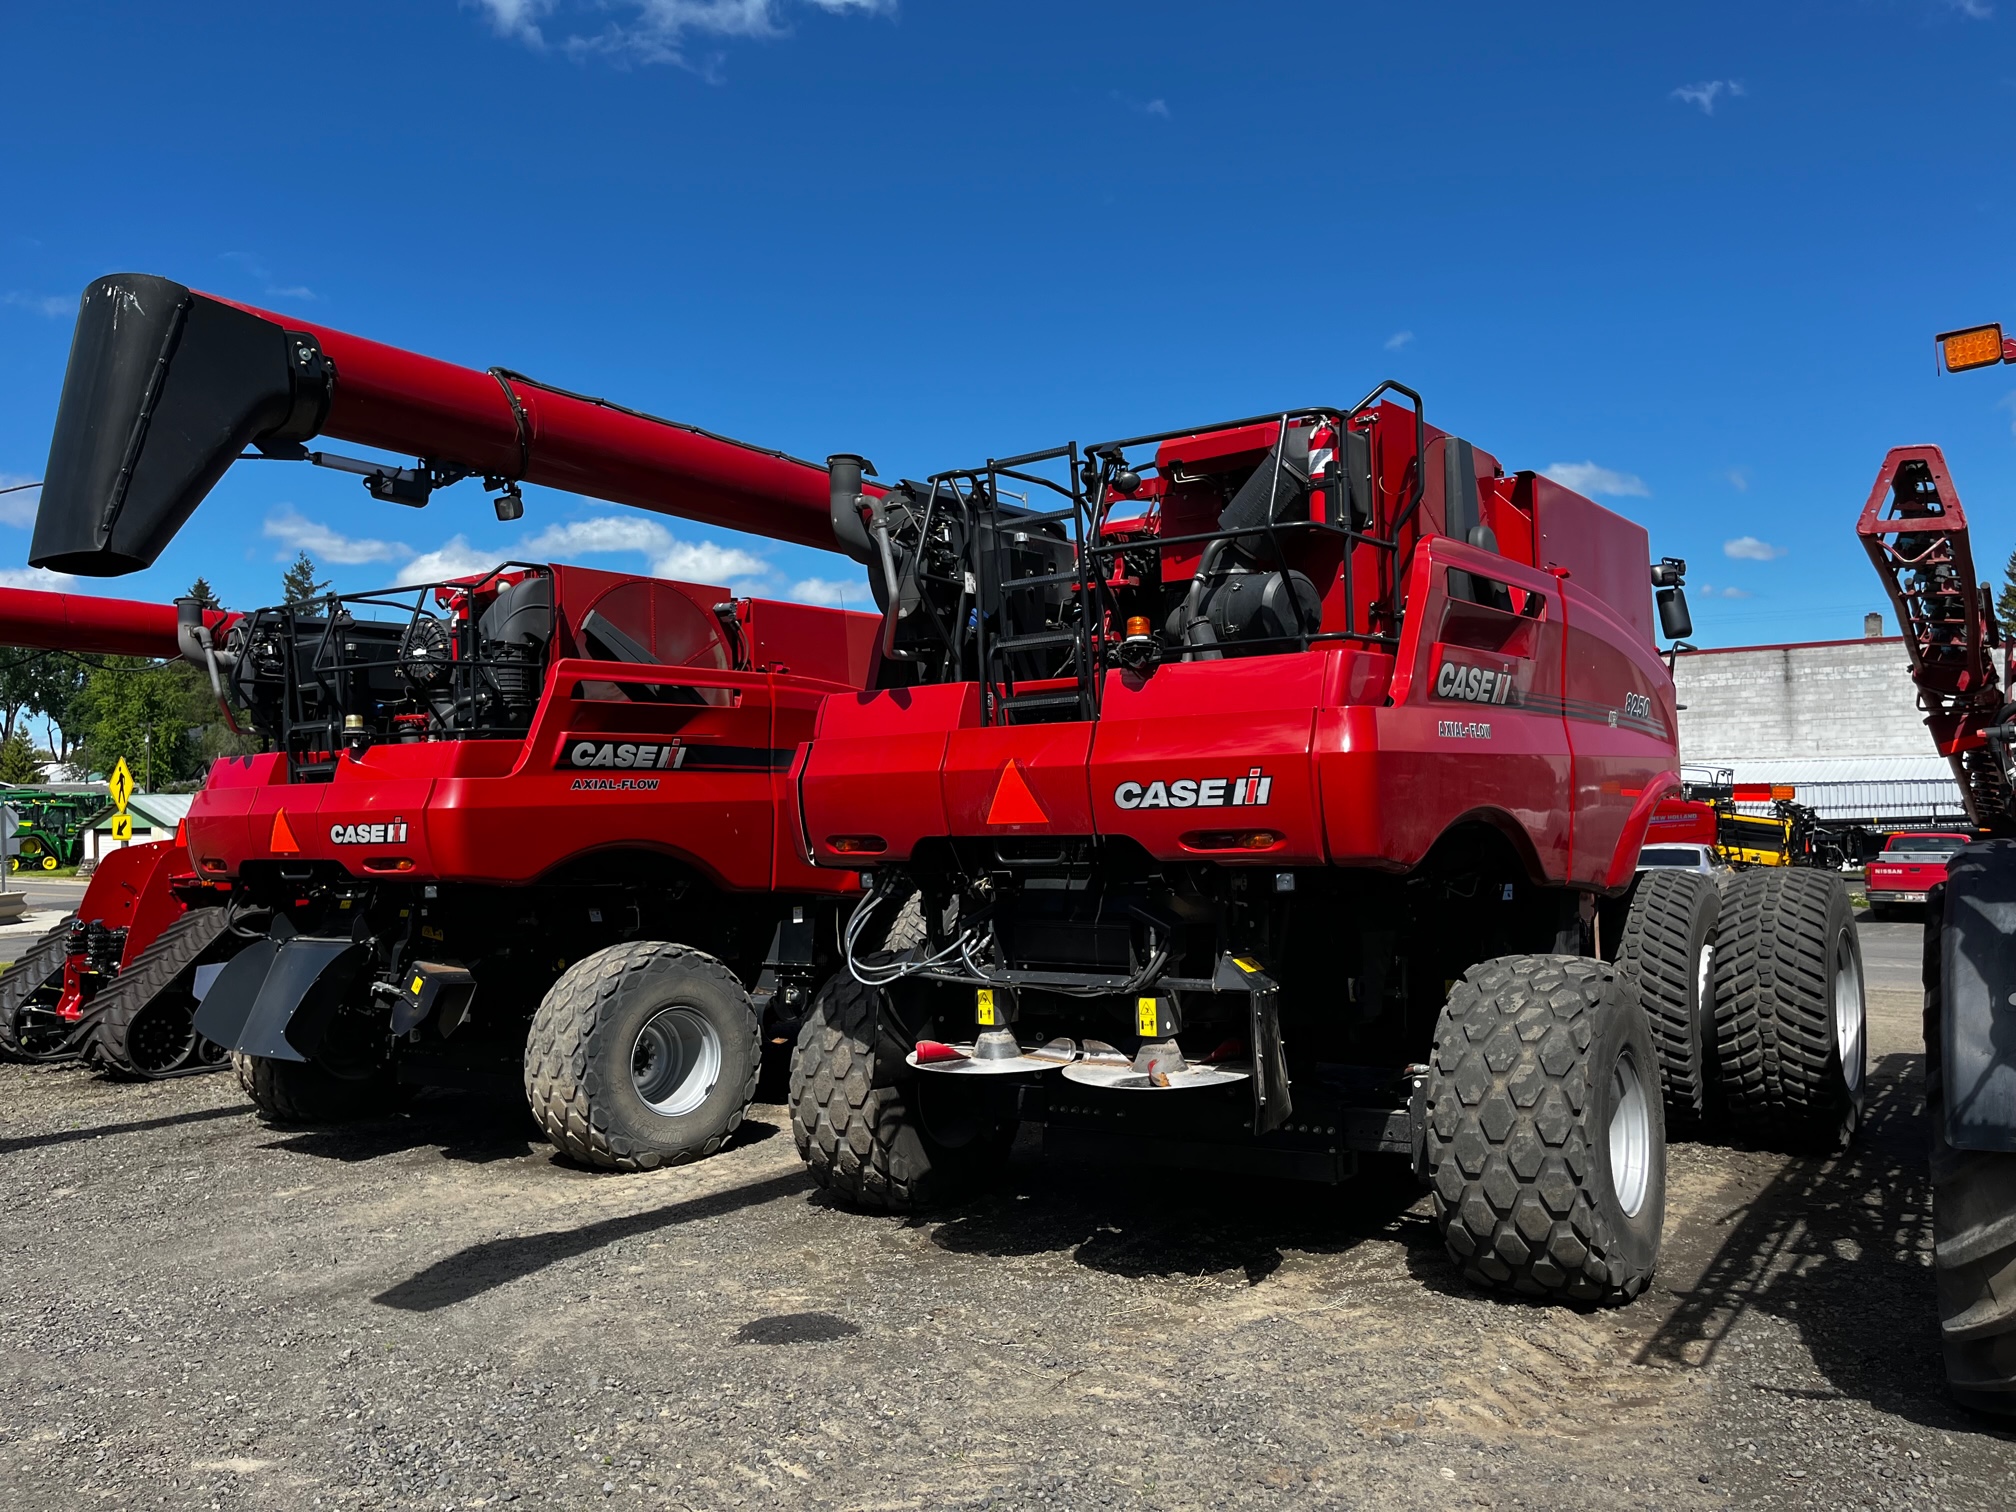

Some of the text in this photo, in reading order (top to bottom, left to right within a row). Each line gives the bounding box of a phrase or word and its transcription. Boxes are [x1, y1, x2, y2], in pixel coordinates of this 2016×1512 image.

[1437, 662, 1495, 703] CASE
[1625, 691, 1651, 720] 8250
[1438, 720, 1492, 739] AXIAL-FLOW
[571, 742, 659, 768] CASE
[570, 778, 660, 791] AXIAL-FLOW
[1114, 779, 1229, 810] CASE
[330, 824, 386, 844] CASE
